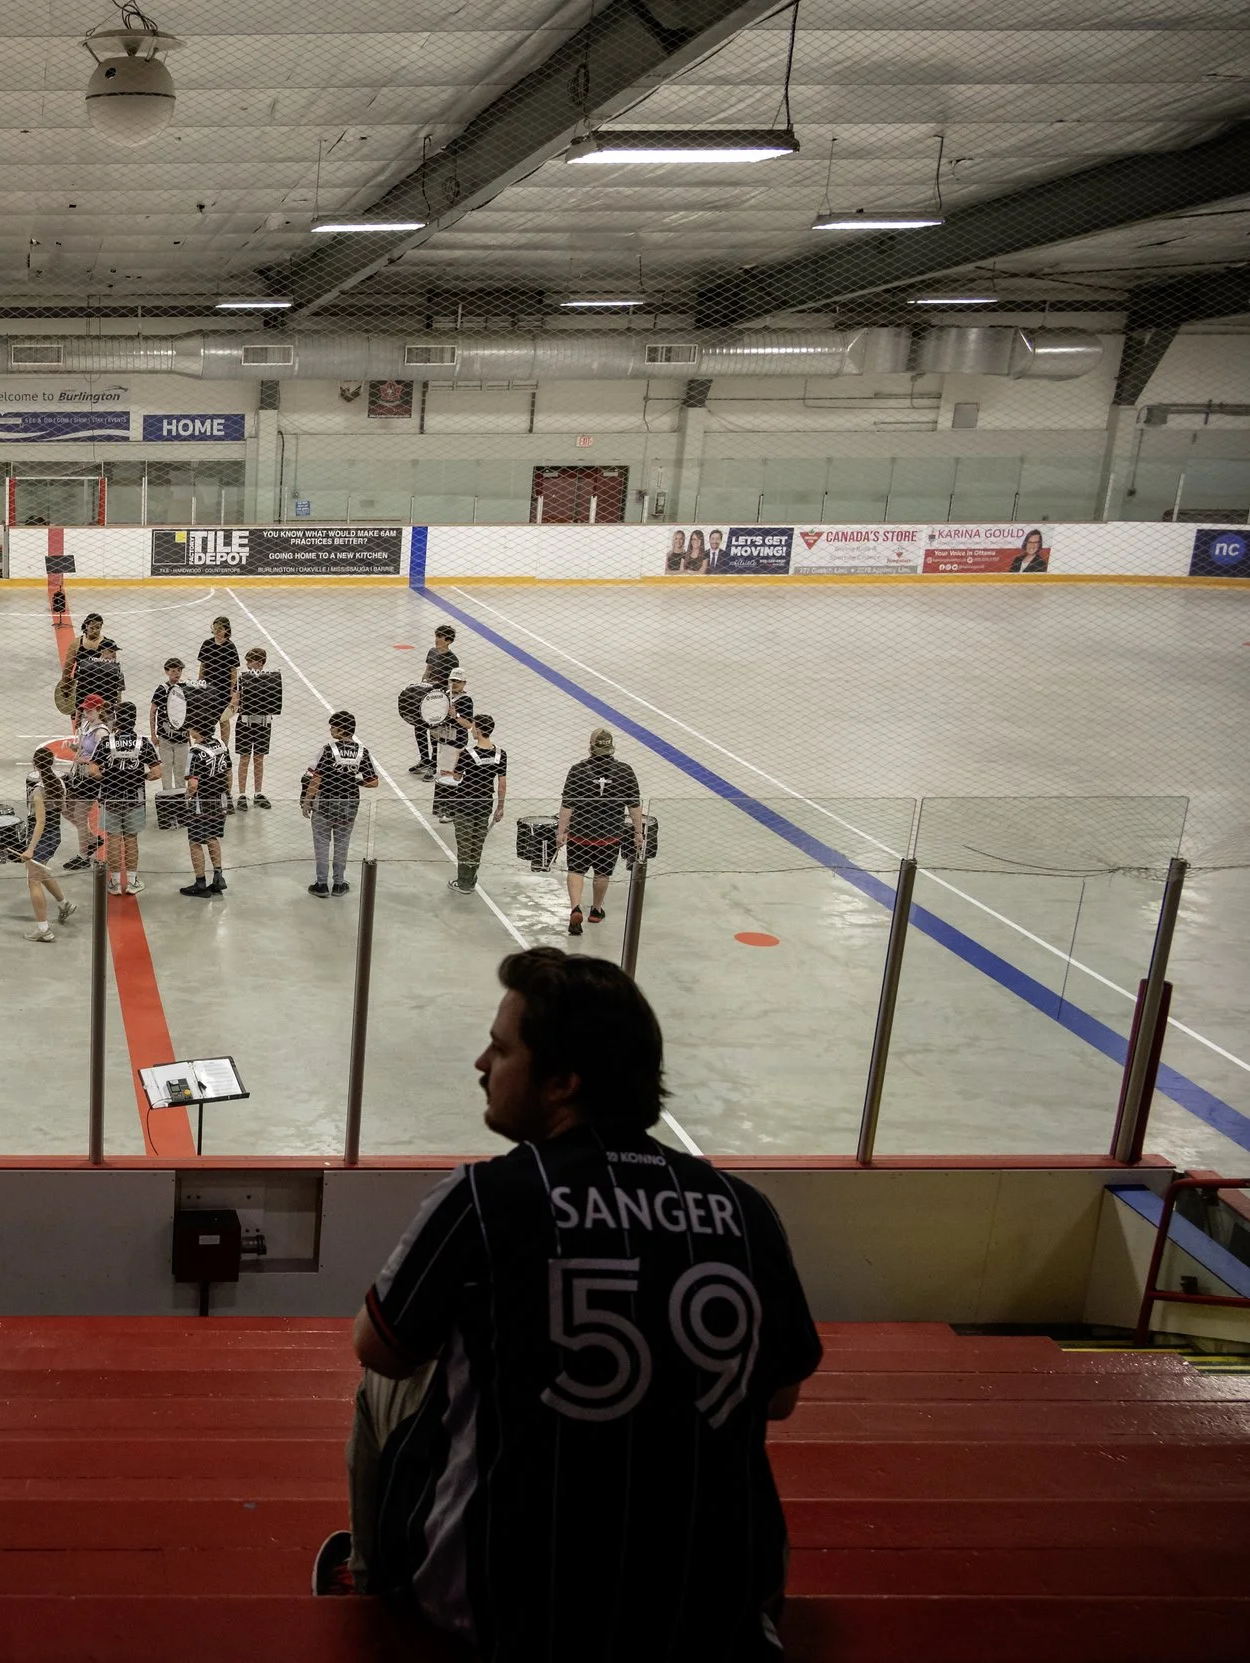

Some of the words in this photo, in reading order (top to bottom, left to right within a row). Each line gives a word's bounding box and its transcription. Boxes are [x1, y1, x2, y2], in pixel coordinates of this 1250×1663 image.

[42, 392, 54, 402] to
[58, 392, 120, 404] Burlington
[162, 419, 225, 436] HOME
[826, 530, 880, 542] CANADA'S
[882, 530, 918, 542] STORE
[938, 529, 980, 539] KARINA
[984, 528, 1025, 538] GOULD
[190, 531, 250, 552] TILE
[732, 536, 762, 545] LET'S
[765, 536, 788, 545] GET
[730, 546, 787, 556] MOVING!
[1214, 543, 1240, 556] nc
[194, 552, 249, 565] DEPOT
[552, 1186, 742, 1238] SANGER
[540, 1257, 762, 1430] 59
